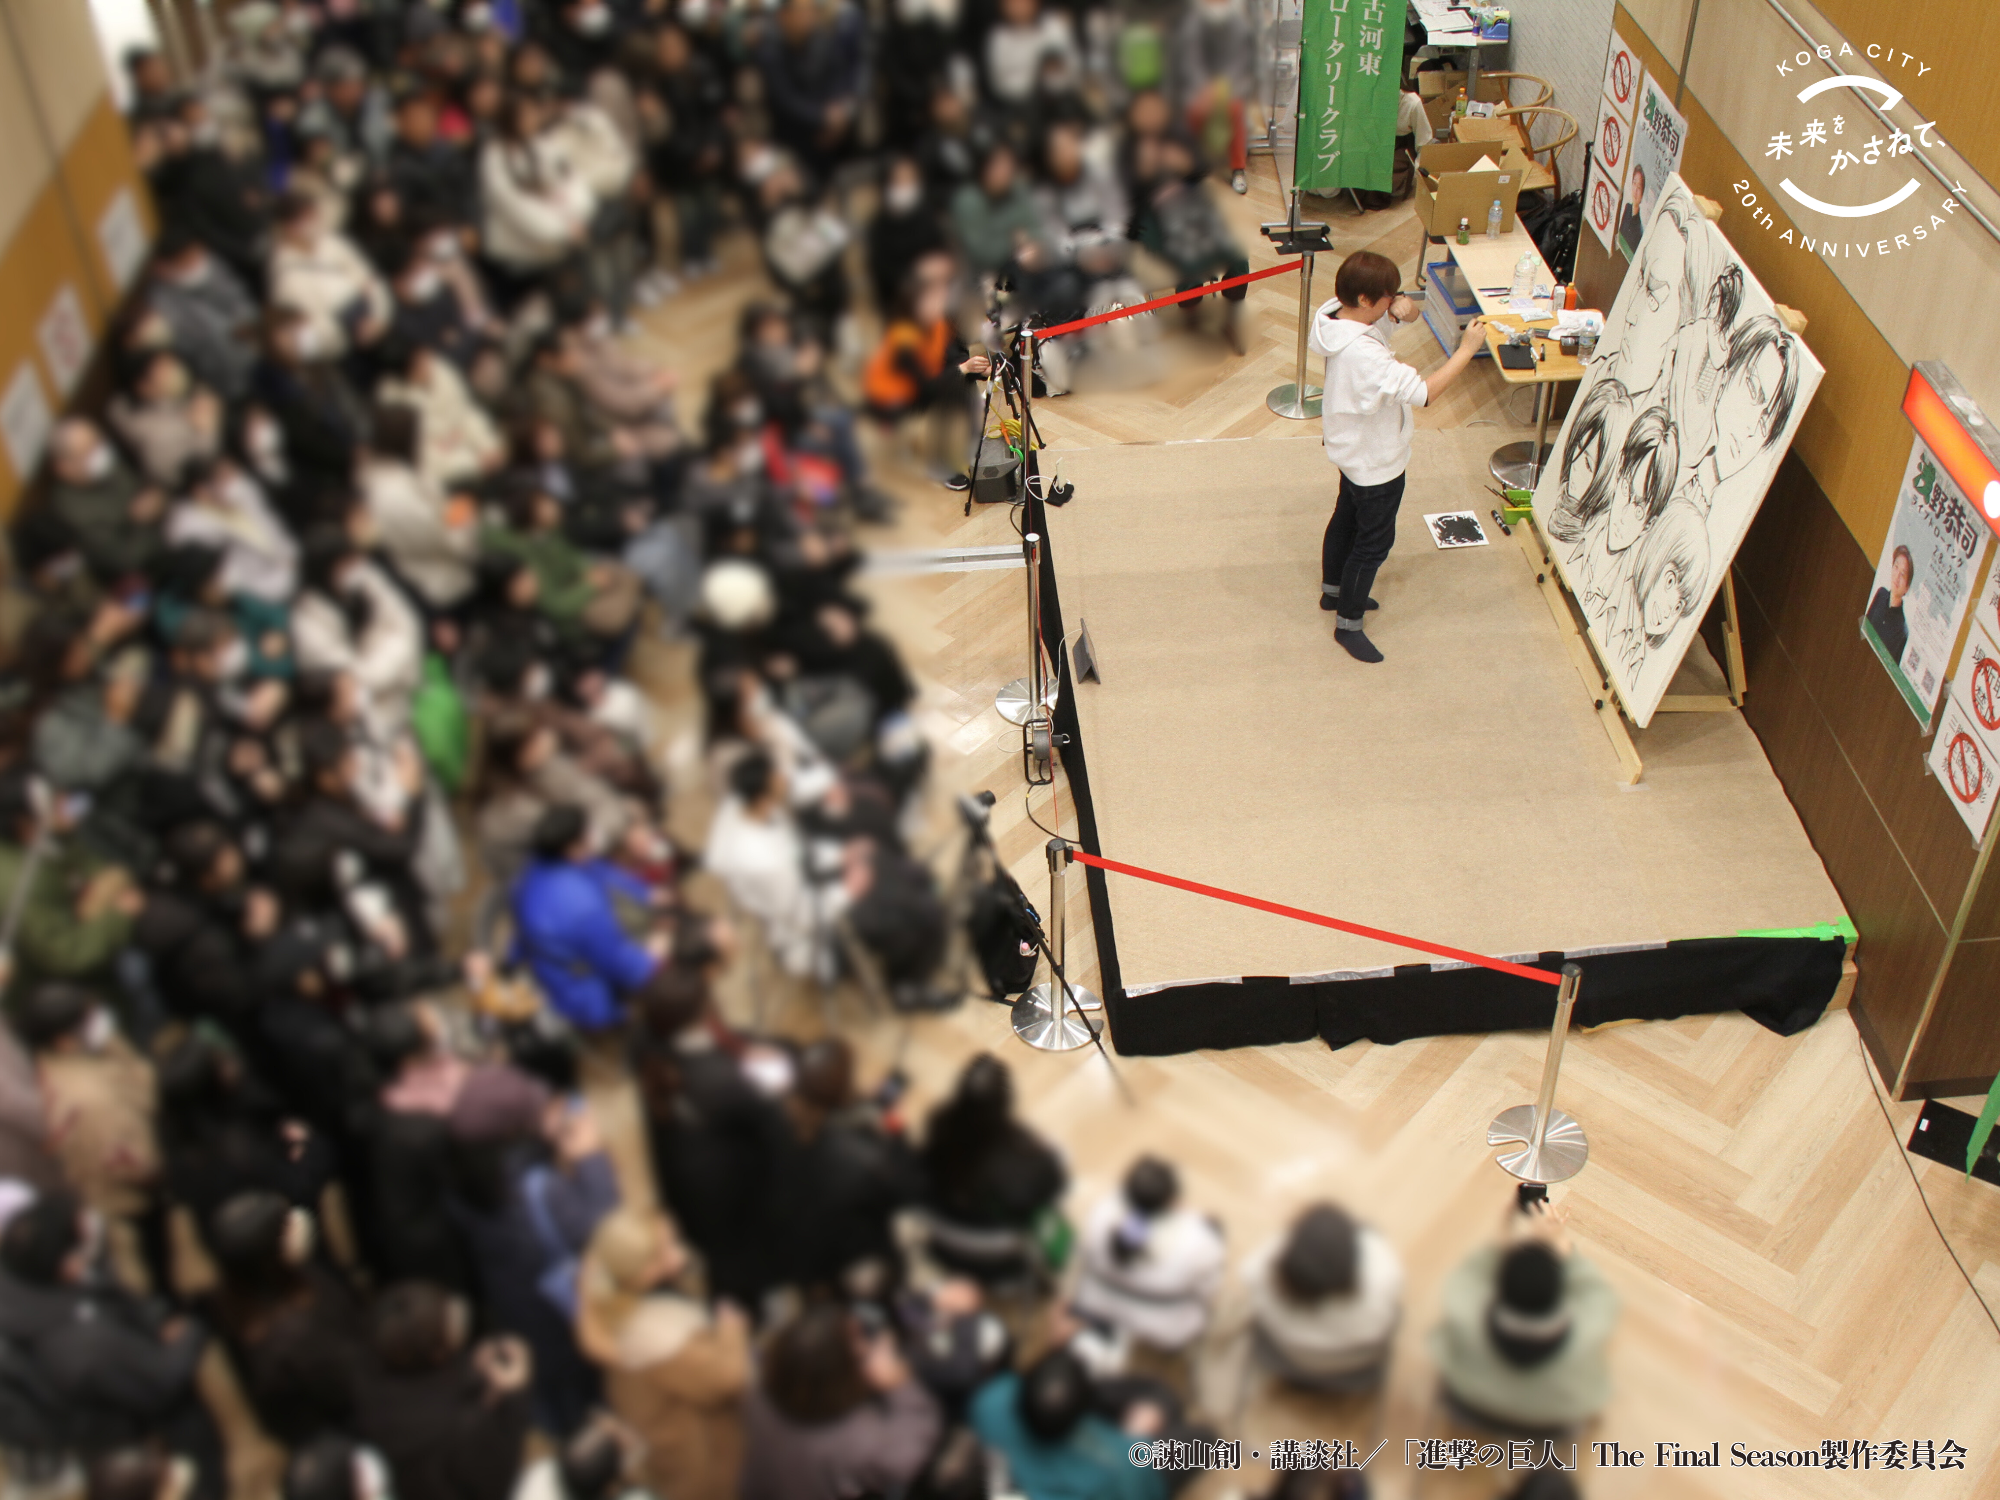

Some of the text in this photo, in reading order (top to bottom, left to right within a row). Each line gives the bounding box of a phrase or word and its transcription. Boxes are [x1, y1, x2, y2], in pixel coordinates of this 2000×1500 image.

[1317, 0, 1350, 173] ロータリークラブ
[1357, 0, 1386, 76] 古河東
